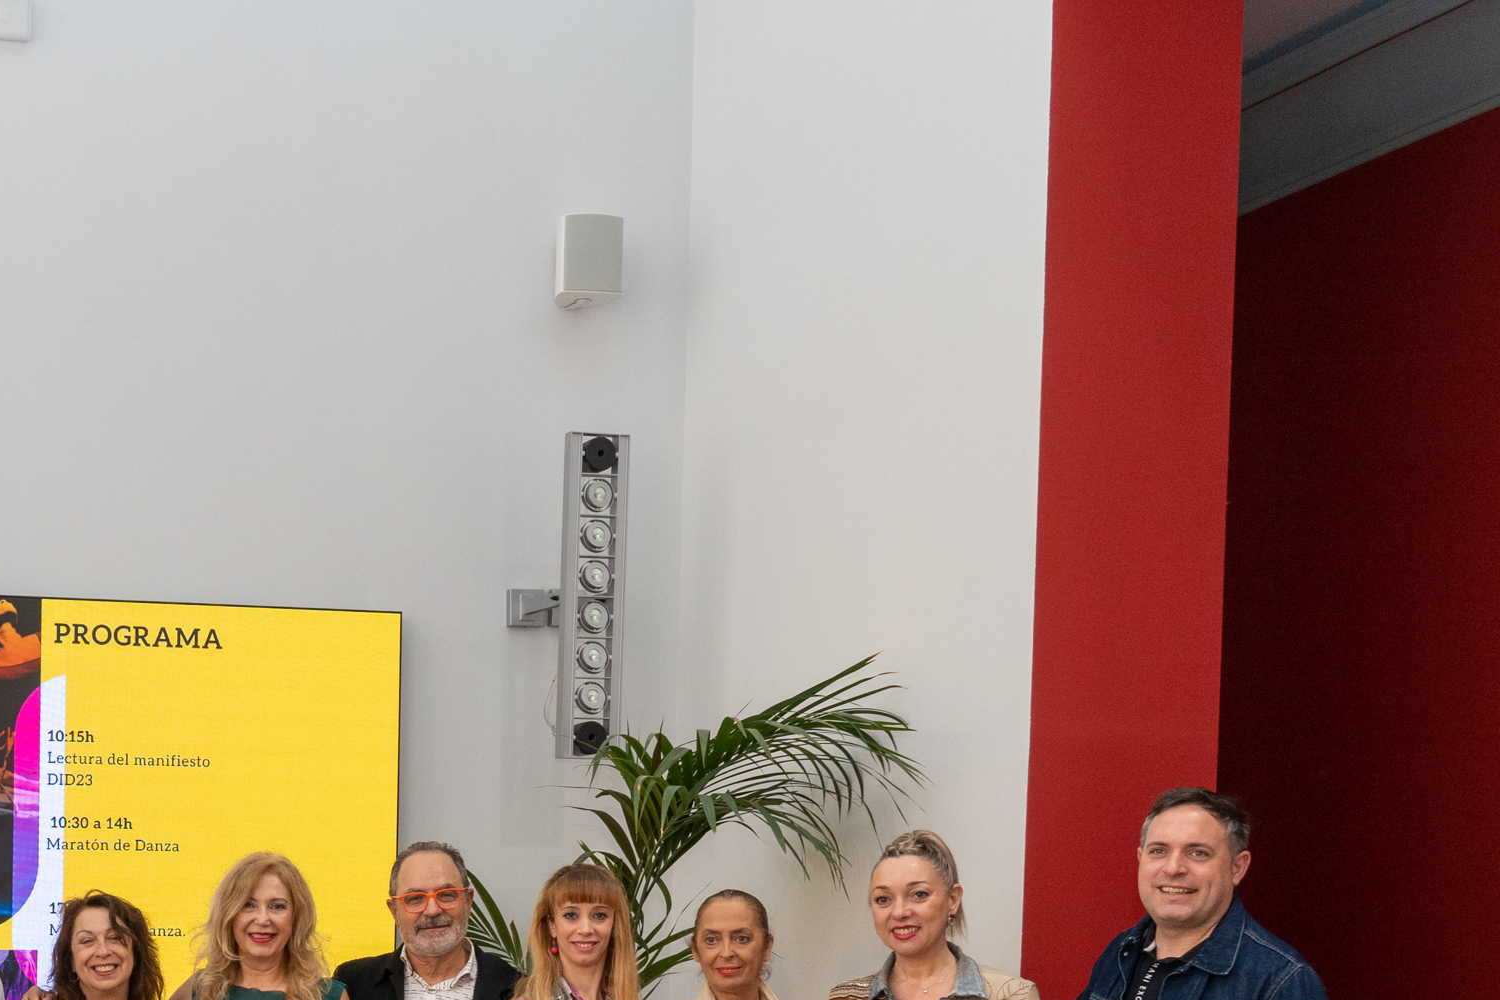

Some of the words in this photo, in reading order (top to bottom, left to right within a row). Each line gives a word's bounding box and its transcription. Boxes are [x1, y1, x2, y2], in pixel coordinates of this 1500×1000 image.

[54, 623, 222, 649] PROGRAMA
[47, 730, 94, 743] 10:15h
[47, 751, 103, 765] Lectura
[107, 753, 129, 766] del
[134, 754, 210, 767] manifiesto
[47, 773, 93, 786] DID23
[50, 817, 89, 828] 10:30
[93, 820, 101, 829] a
[106, 818, 133, 829] 14h
[47, 838, 109, 851] Maratón
[114, 839, 130, 851] de
[134, 840, 179, 852] Danza
